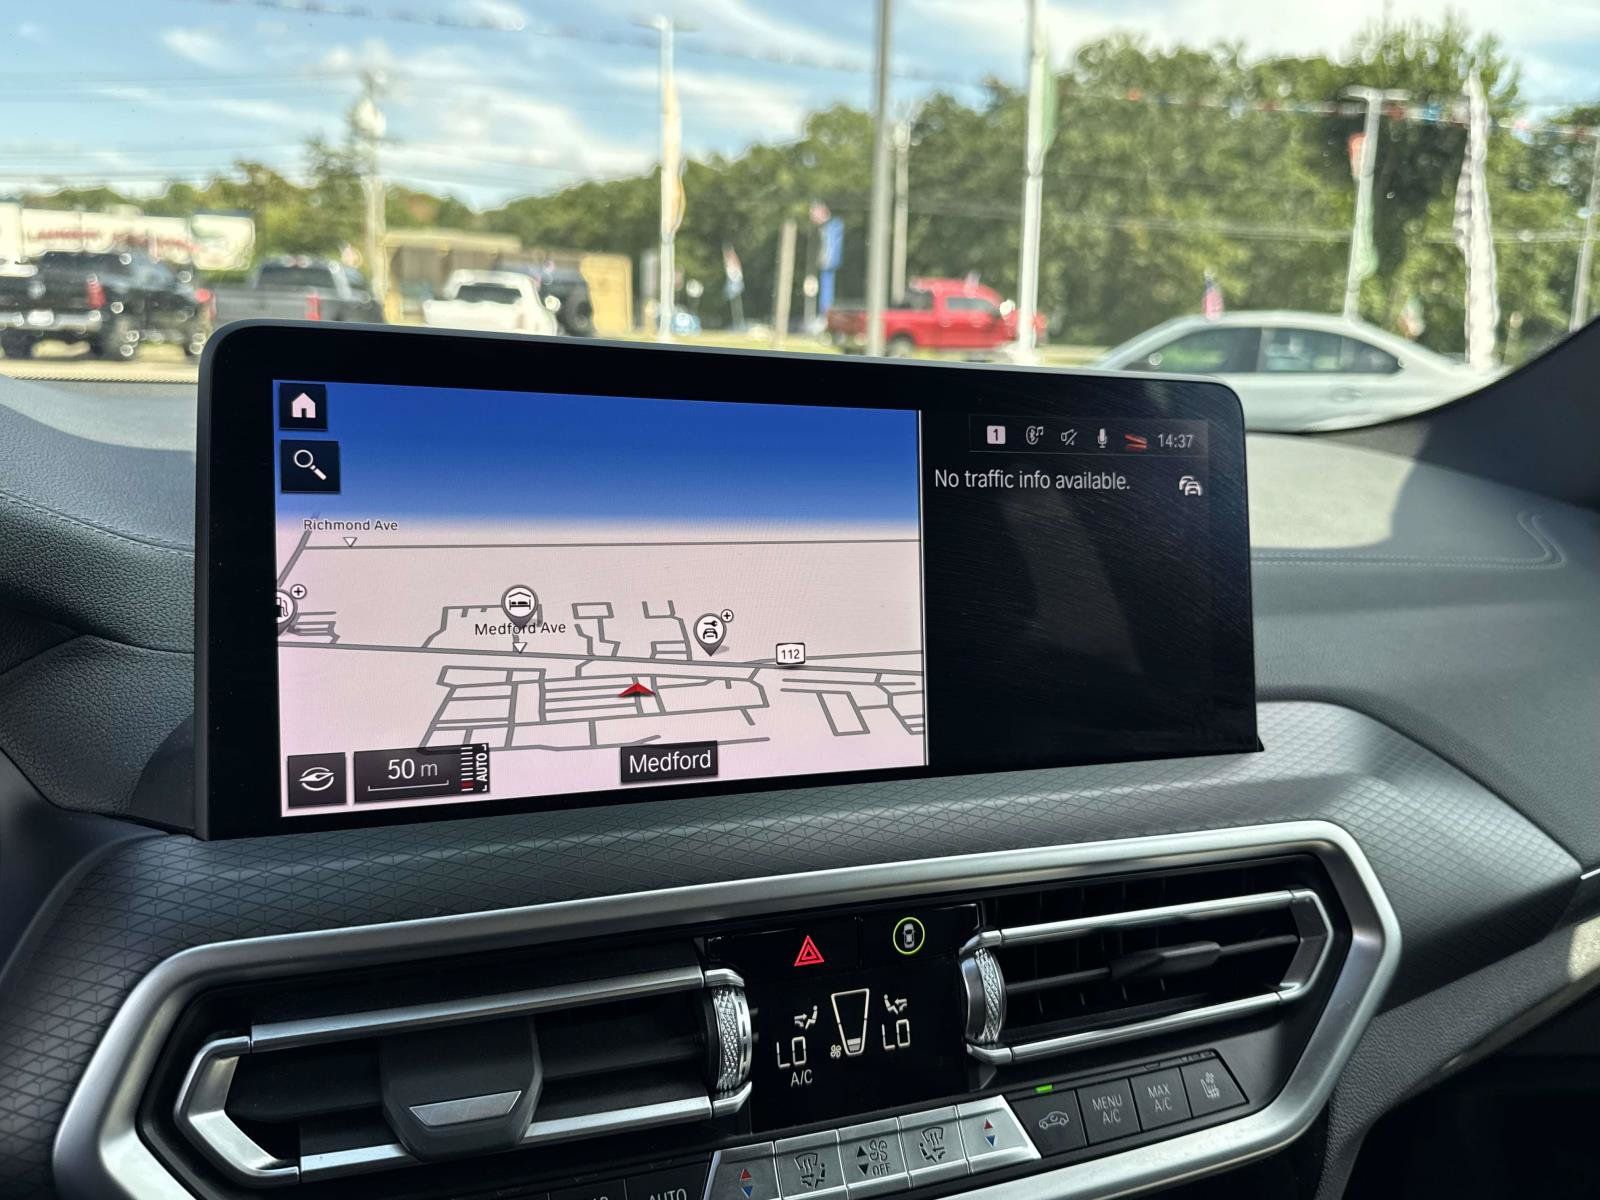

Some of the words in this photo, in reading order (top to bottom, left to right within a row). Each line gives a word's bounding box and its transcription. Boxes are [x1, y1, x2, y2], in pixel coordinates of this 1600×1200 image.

[1157, 433, 1193, 449] 14:37
[935, 469, 959, 488] No
[964, 469, 1014, 489] traffic
[1019, 470, 1051, 489] info
[1055, 471, 1131, 490] available.
[303, 519, 371, 531] Richmond
[374, 520, 398, 531] Ave
[474, 622, 536, 636] Medford
[540, 622, 566, 634] Ave
[781, 648, 800, 660] 112
[388, 758, 415, 779] 50
[420, 763, 438, 777] m
[476, 752, 488, 782] AUTO
[628, 750, 712, 774] Medford
[790, 1068, 814, 1088] A/C
[1146, 1083, 1171, 1098] MAX
[1091, 1094, 1123, 1111] MENU
[1154, 1097, 1173, 1112] A/C
[1102, 1108, 1121, 1125] A/C
